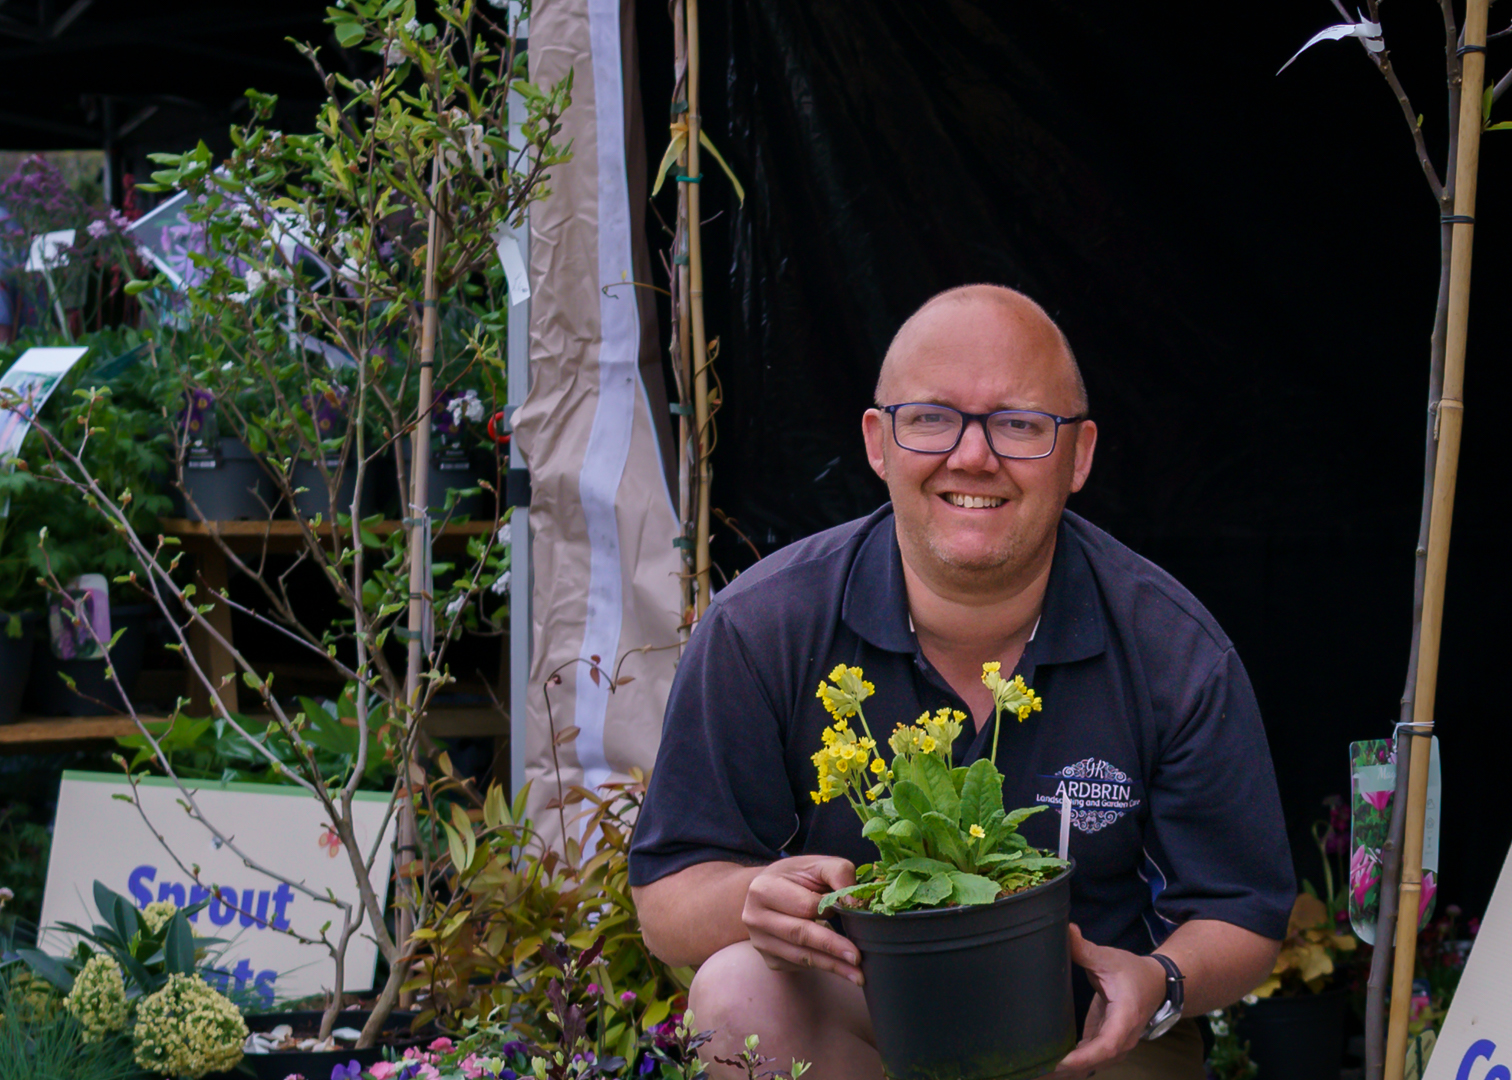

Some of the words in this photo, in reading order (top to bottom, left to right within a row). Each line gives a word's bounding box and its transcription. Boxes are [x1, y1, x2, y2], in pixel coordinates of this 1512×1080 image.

[1055, 780, 1131, 800] ARDBRIN
[1036, 793, 1084, 808] Landscing
[1085, 798, 1100, 807] and
[1101, 798, 1128, 809] Garden
